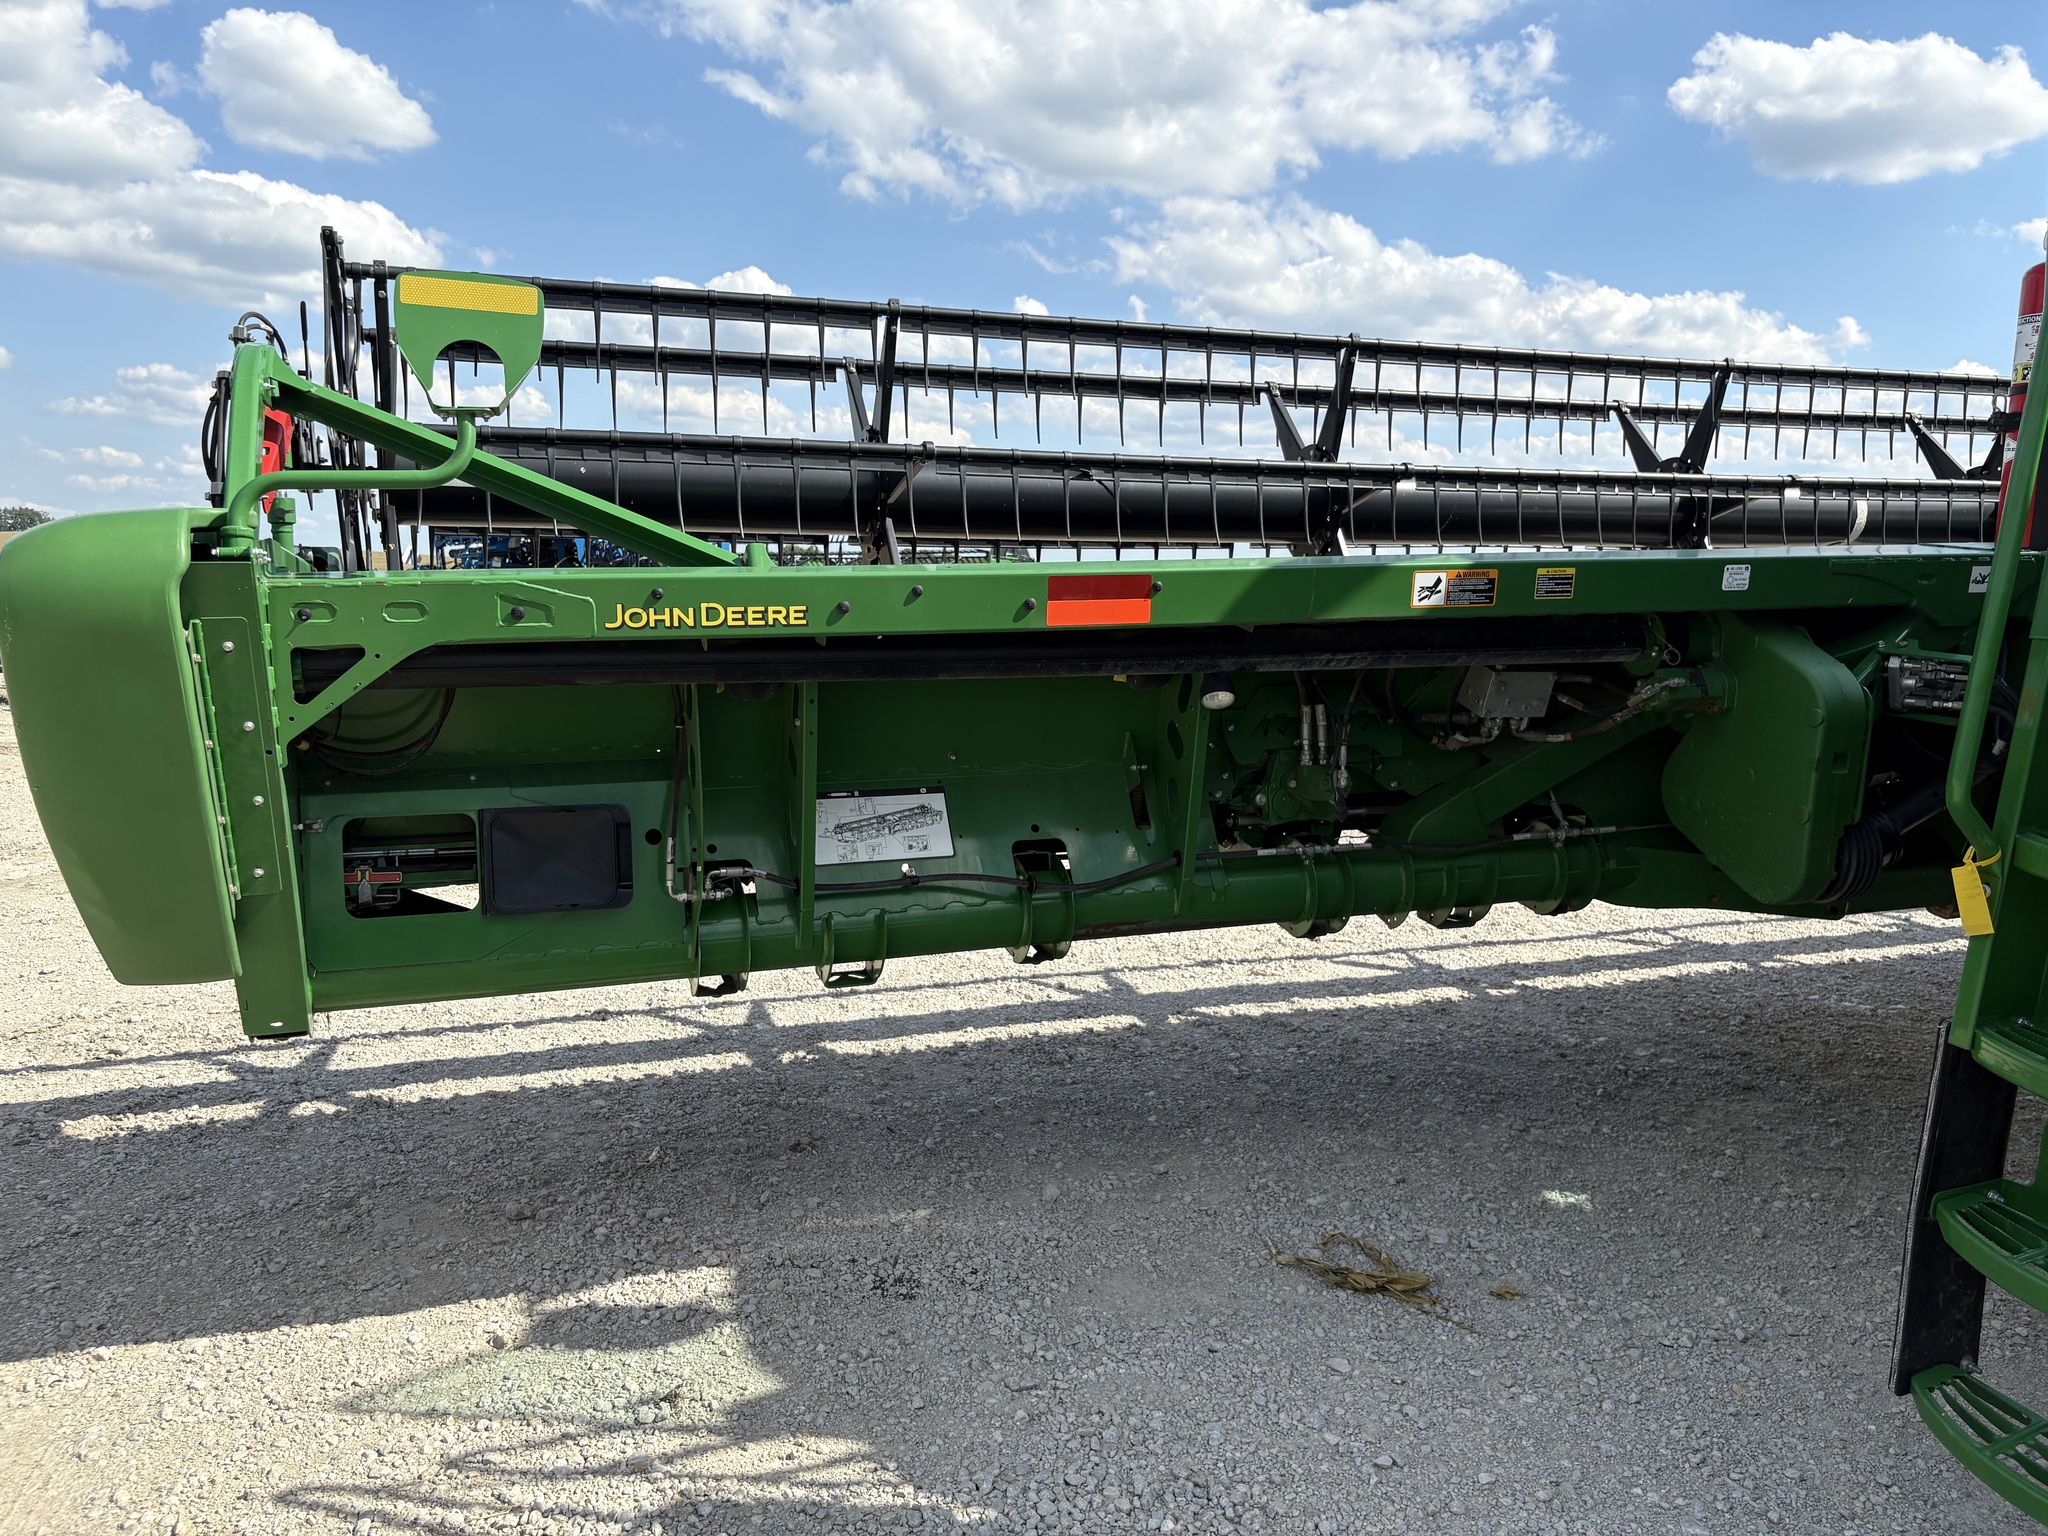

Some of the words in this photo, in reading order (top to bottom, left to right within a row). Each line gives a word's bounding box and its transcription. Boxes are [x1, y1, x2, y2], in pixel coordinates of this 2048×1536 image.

[1462, 570, 1490, 578] WARNING
[604, 603, 696, 630] JOHN
[700, 602, 809, 628] DEERE
